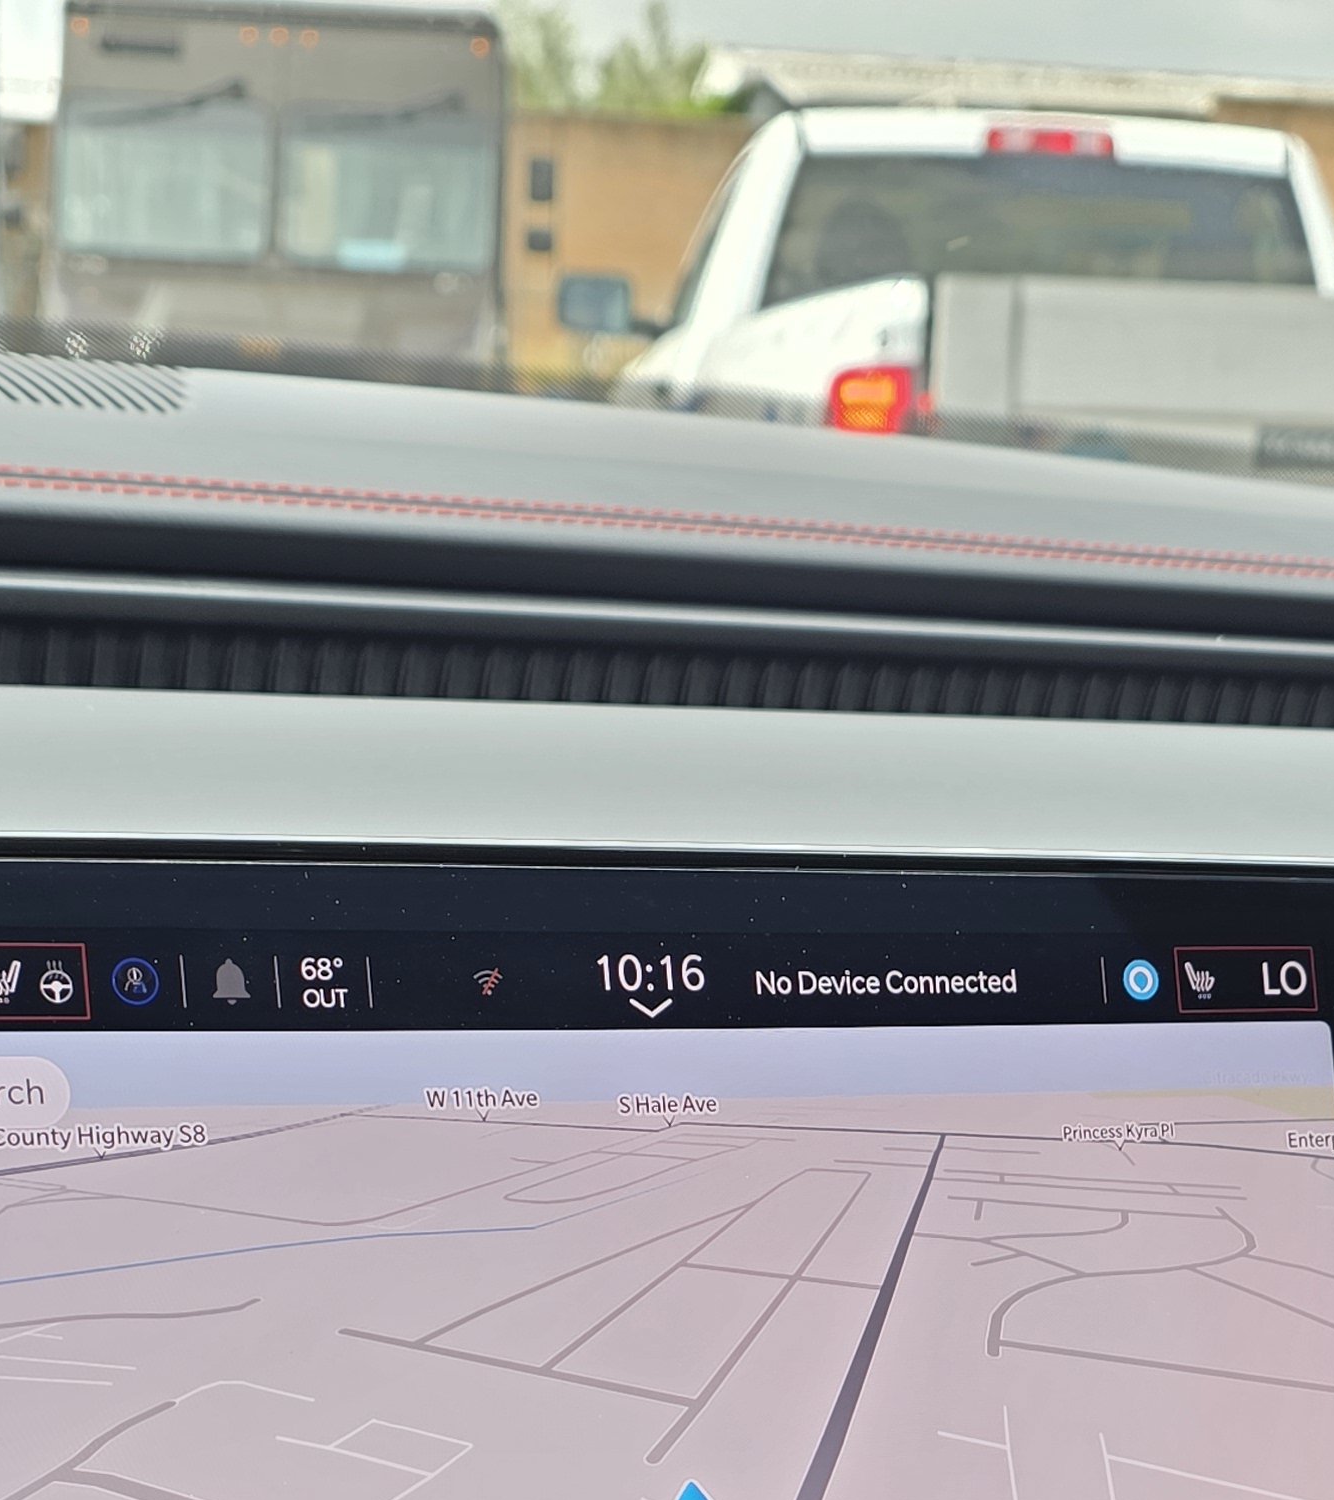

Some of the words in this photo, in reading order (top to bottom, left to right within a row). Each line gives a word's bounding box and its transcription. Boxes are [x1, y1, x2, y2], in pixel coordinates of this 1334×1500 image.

[300, 957, 344, 981] 68°
[596, 952, 705, 994] 10:16
[1261, 960, 1307, 997] LO
[755, 970, 792, 995] No
[798, 970, 881, 995] Device
[886, 969, 1018, 994] Connected
[302, 987, 348, 1009] OUT
[426, 1089, 447, 1108] W
[451, 1088, 496, 1108] 11th
[498, 1089, 538, 1107] Ave
[619, 1096, 630, 1114] S
[634, 1096, 678, 1114] Hale
[681, 1095, 717, 1113] Ave
[76, 1125, 173, 1149] Highway
[179, 1124, 207, 1144] S8
[1062, 1124, 1123, 1141] Princess
[1123, 1123, 1158, 1142] Kyra
[1161, 1123, 1175, 1138] Pl
